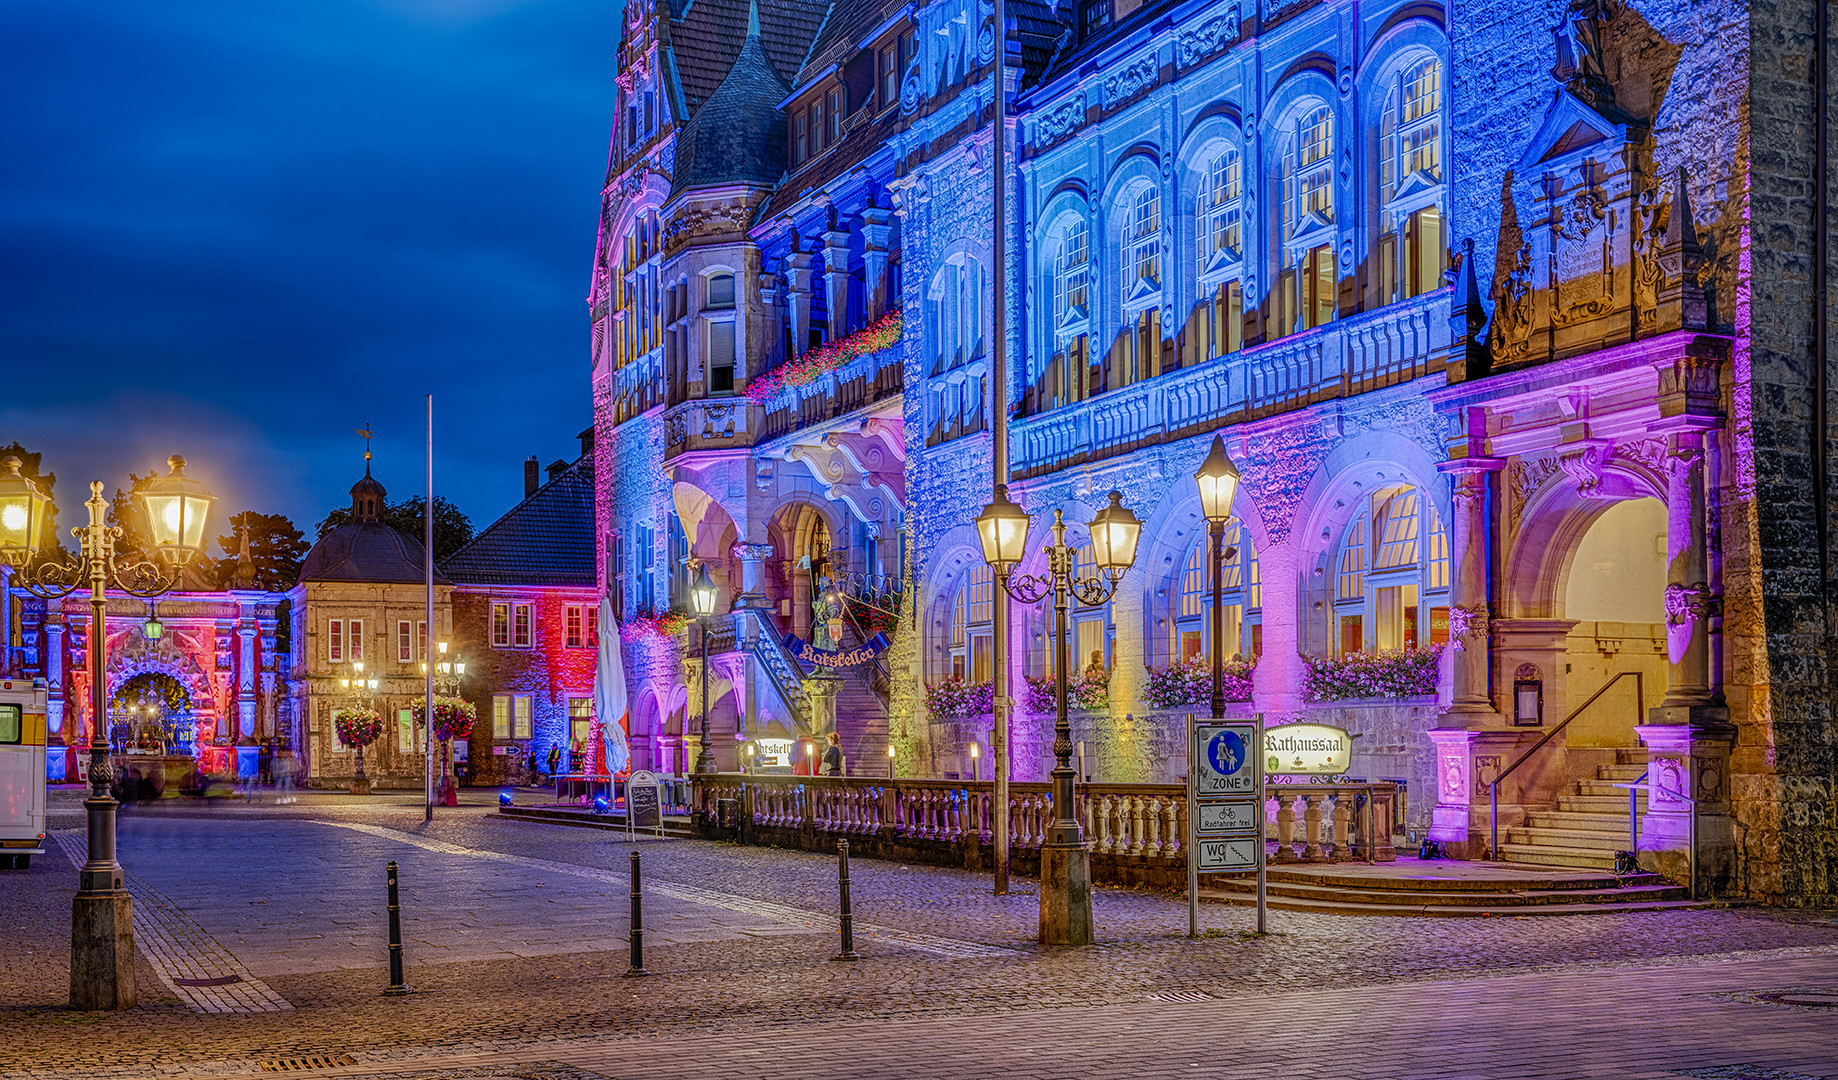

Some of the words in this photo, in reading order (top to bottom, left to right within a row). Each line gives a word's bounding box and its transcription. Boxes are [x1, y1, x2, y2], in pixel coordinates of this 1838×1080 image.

[799, 643, 876, 668] Ratskeller
[1264, 734, 1344, 754] Rathaussaal
[1212, 778, 1241, 789] ZONE
[1204, 819, 1237, 828] Radfahrer
[1239, 818, 1251, 827] frei
[1206, 844, 1226, 856] WC
